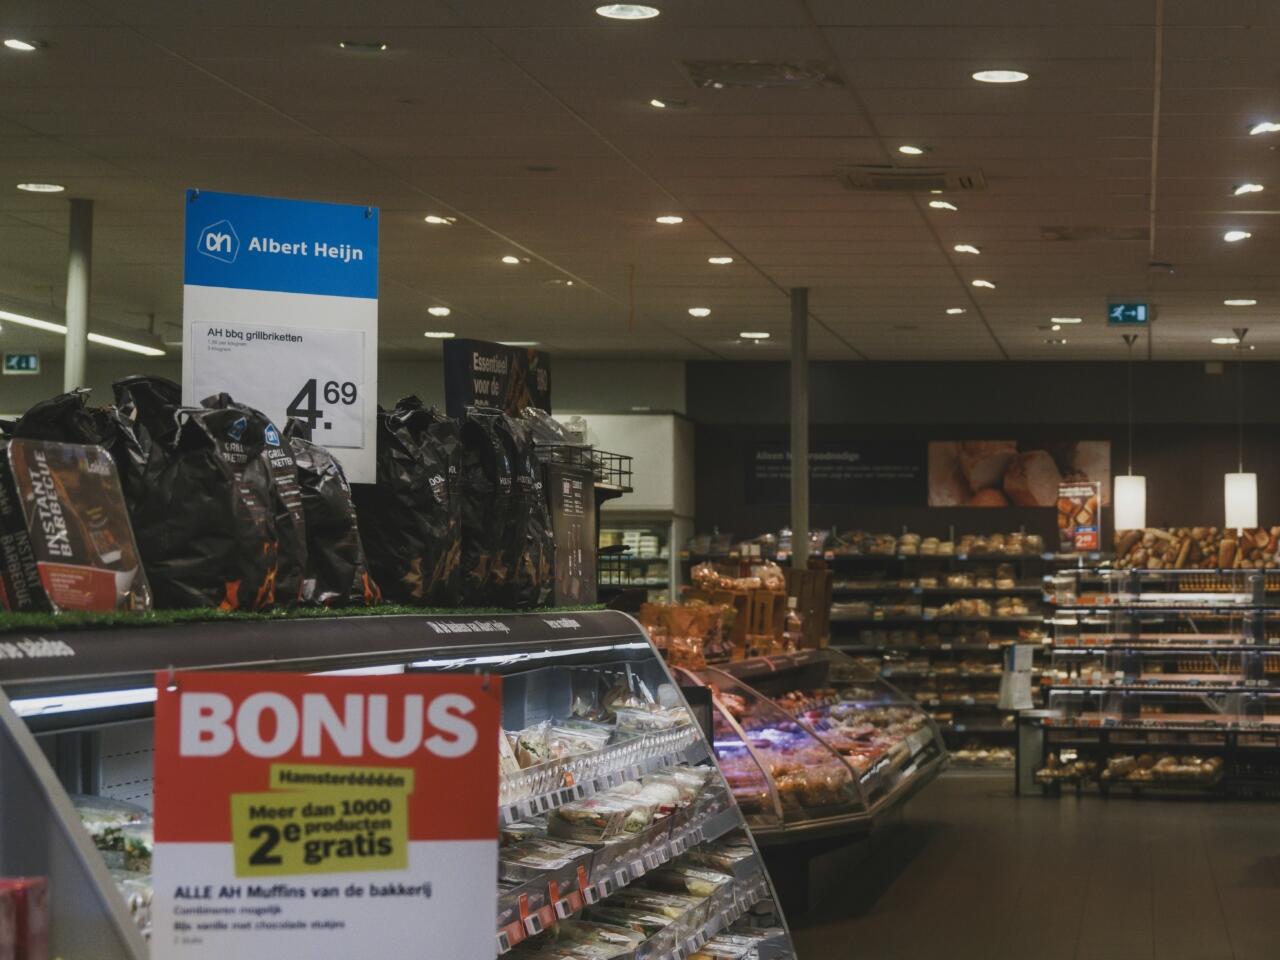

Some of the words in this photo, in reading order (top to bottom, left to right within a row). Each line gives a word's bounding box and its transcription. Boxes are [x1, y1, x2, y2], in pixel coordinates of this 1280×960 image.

[248, 236, 308, 256] Albert
[314, 242, 363, 262] Heijn
[207, 328, 223, 337] AH
[225, 329, 243, 340] bbq
[246, 331, 303, 343] grillbriketten
[268, 449, 286, 459] GRILL
[29, 469, 61, 556] INSTANT
[34, 450, 74, 557] BARBECUE
[179, 691, 478, 759] BONUS
[249, 804, 295, 821] Meer
[302, 801, 336, 818] dan
[341, 798, 392, 817] 1000
[304, 817, 392, 836] producten
[303, 832, 393, 866] gratis
[174, 885, 213, 900] ALLE
[218, 885, 242, 899] AH
[247, 883, 305, 898] Muffins
[311, 886, 340, 898] van
[345, 883, 364, 898] de
[369, 881, 432, 899] bakkerij
